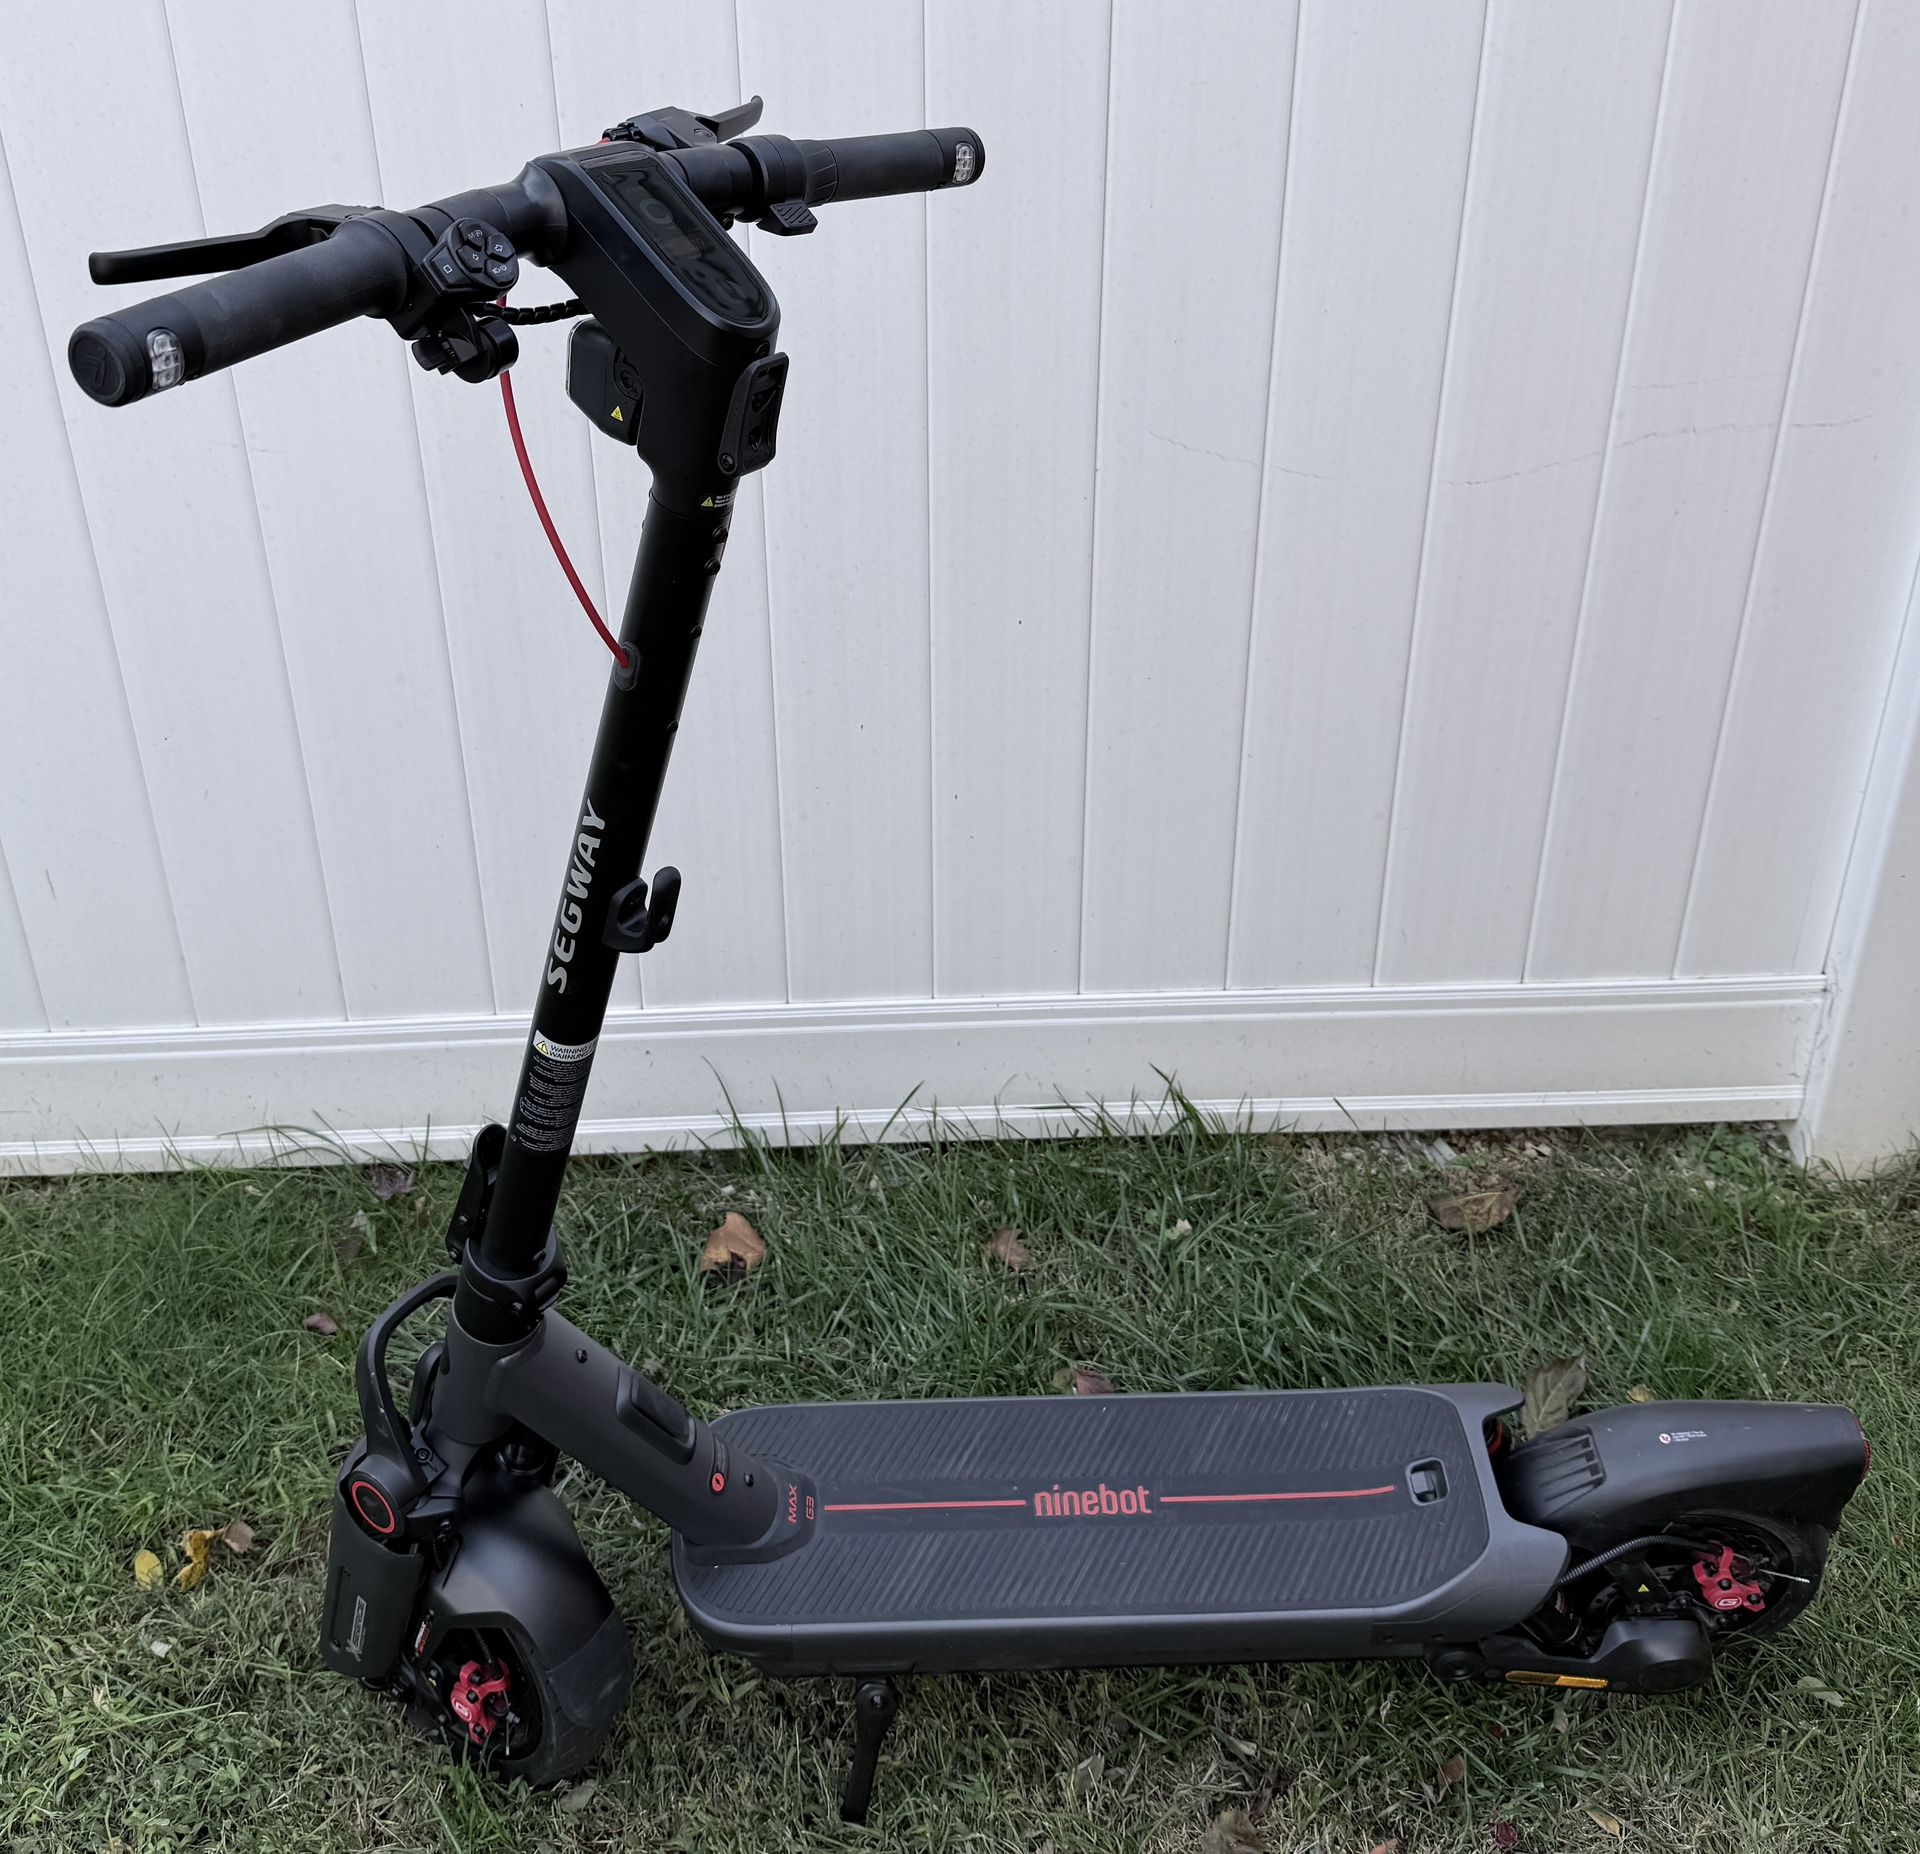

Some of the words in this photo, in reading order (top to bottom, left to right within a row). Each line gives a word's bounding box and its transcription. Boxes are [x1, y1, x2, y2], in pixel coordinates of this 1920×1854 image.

[547, 797, 606, 994] SEGWAY
[788, 1482, 798, 1524] MAX
[805, 1495, 814, 1520] G3
[1034, 1484, 1152, 1516] ninebot
